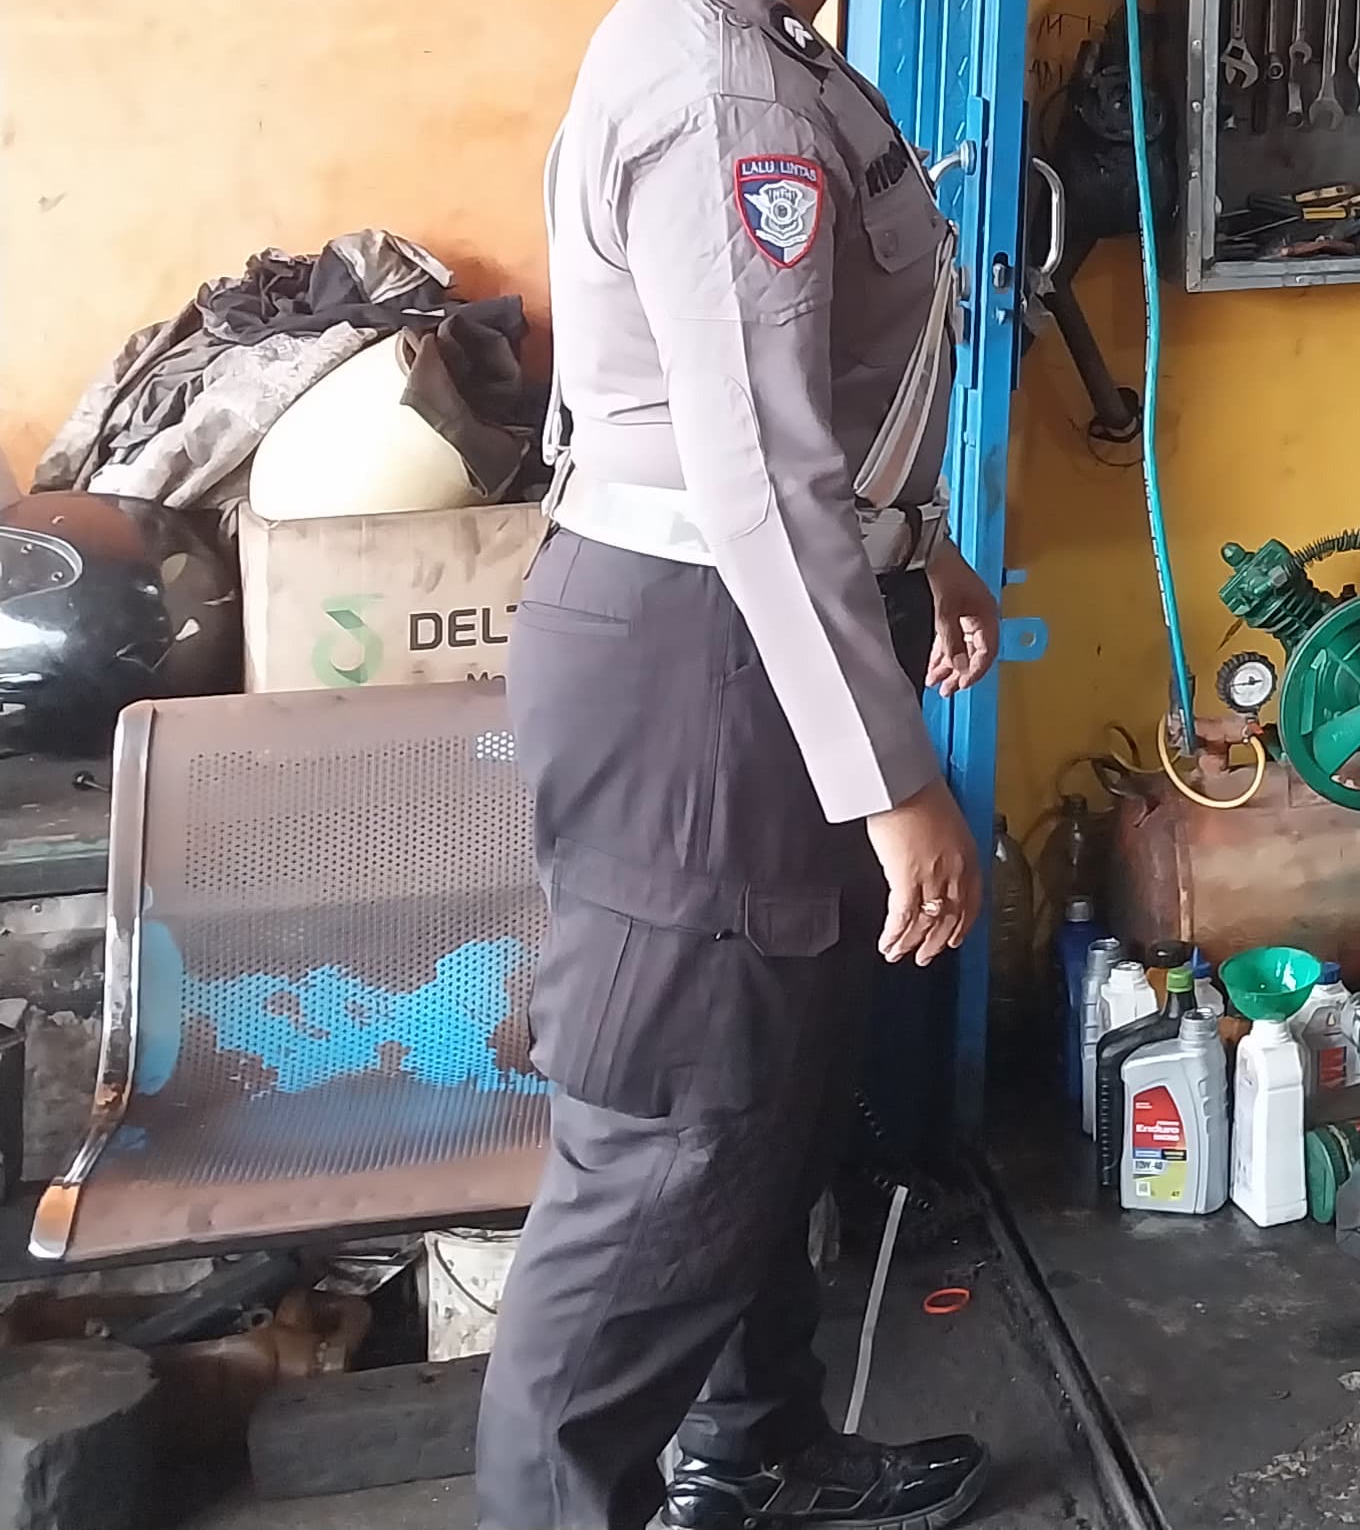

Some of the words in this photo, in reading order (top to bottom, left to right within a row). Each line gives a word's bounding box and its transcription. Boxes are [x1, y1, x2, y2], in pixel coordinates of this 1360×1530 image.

[742, 160, 774, 176] LALU
[781, 160, 817, 182] LINTAS
[1135, 1123, 1180, 1135] Enduro
